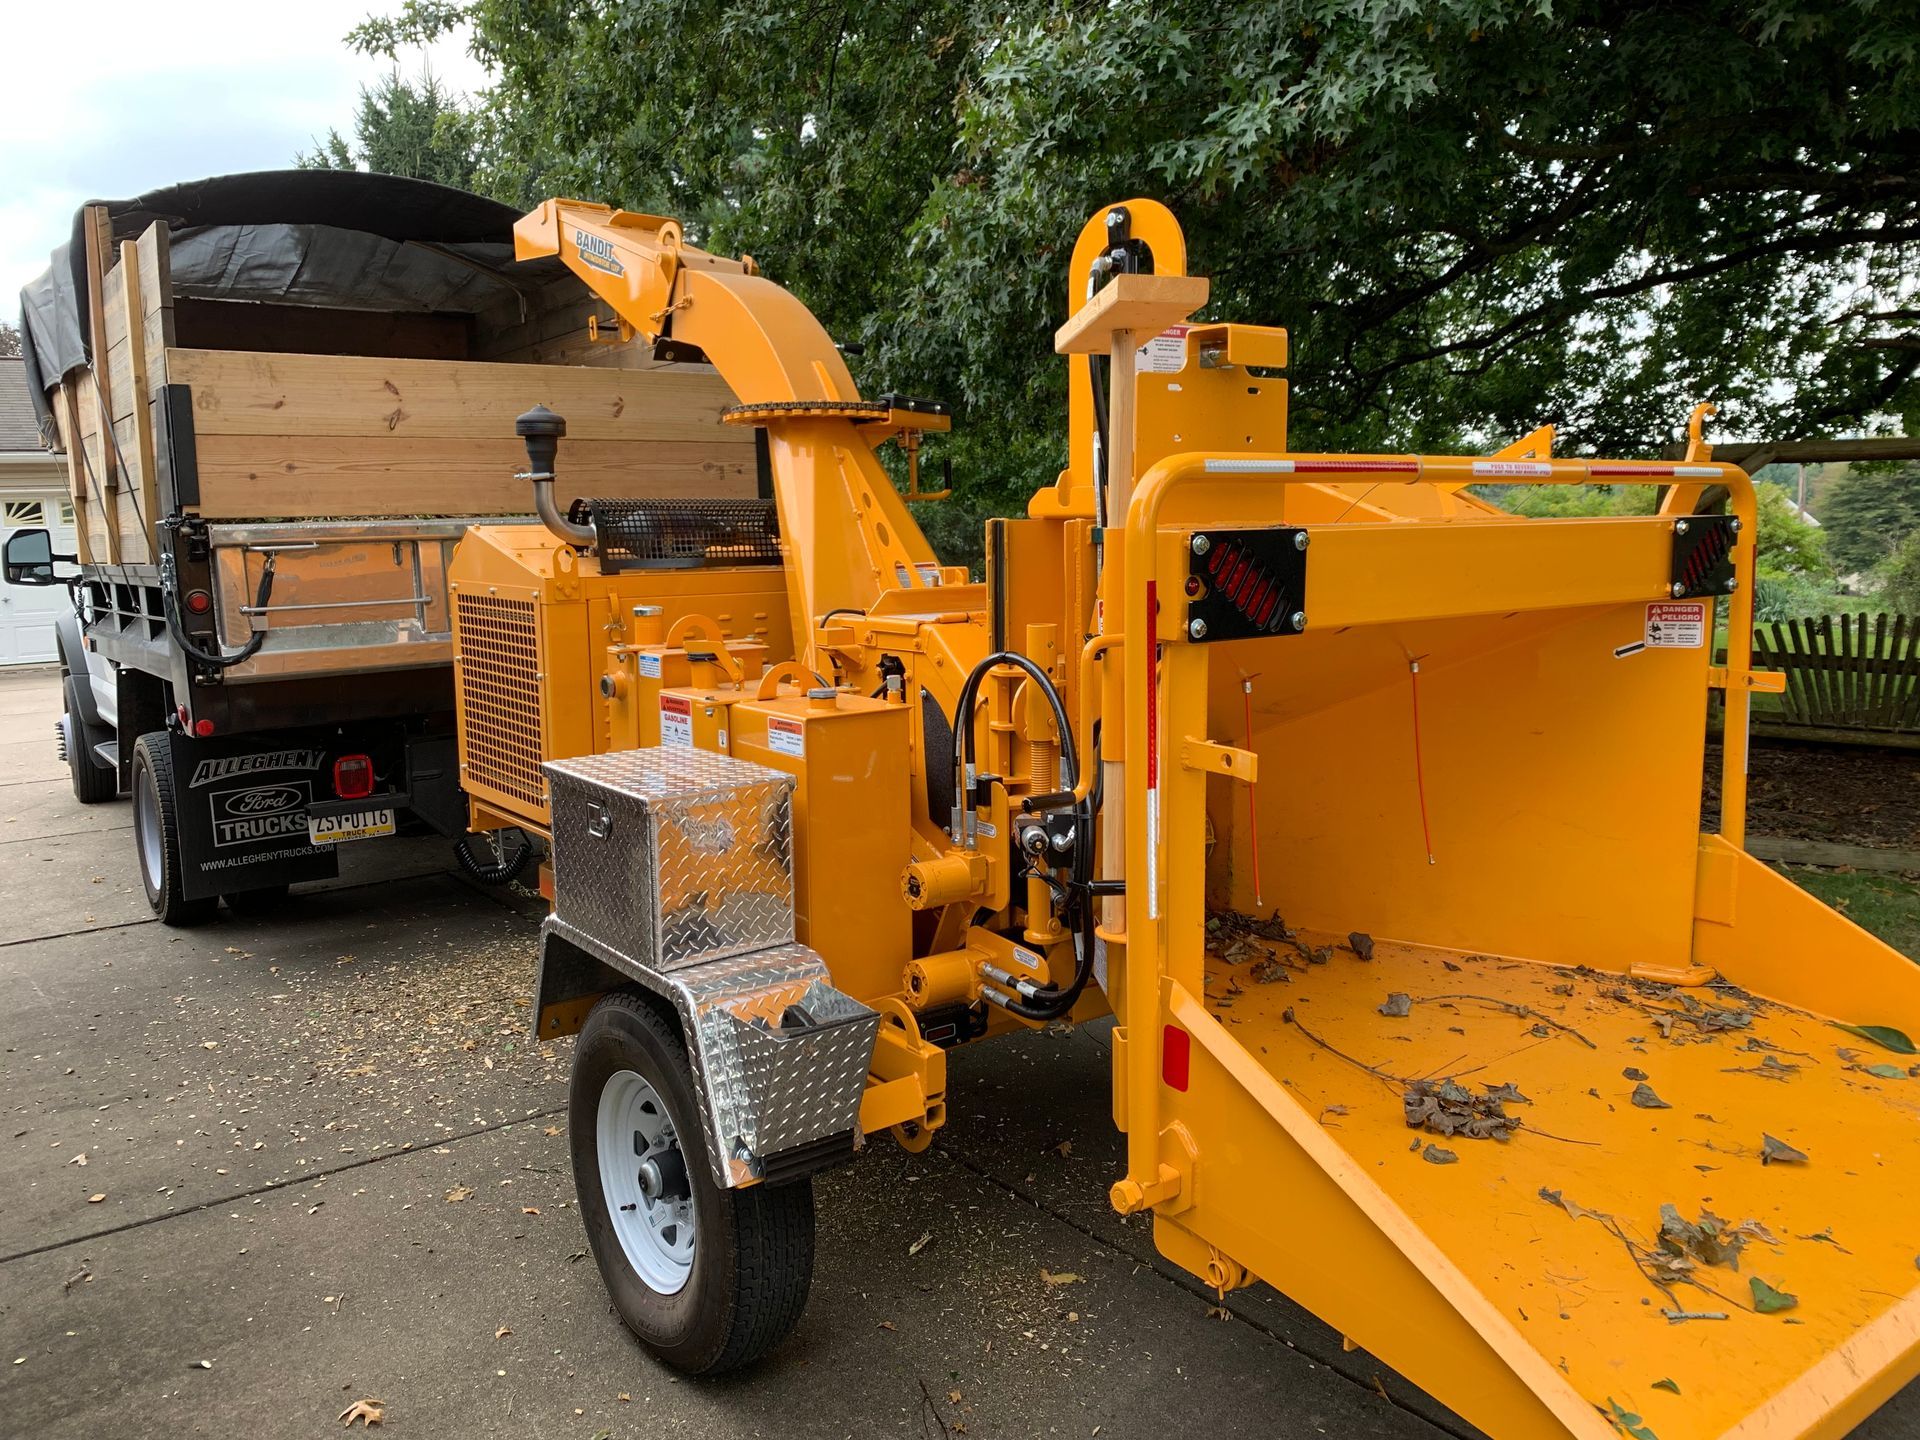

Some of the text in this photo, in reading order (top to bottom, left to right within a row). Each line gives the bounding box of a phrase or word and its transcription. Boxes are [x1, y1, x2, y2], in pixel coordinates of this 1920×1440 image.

[576, 230, 614, 260] BANDIT
[664, 713, 688, 725] GASOLINE
[189, 750, 326, 789] ALLEGHENY
[240, 791, 287, 812] Ford
[220, 813, 308, 841] TRUCKS
[342, 829, 367, 837] TRUCK
[200, 844, 335, 872] WWW.ALLEGHENYTRUCKS.COM
